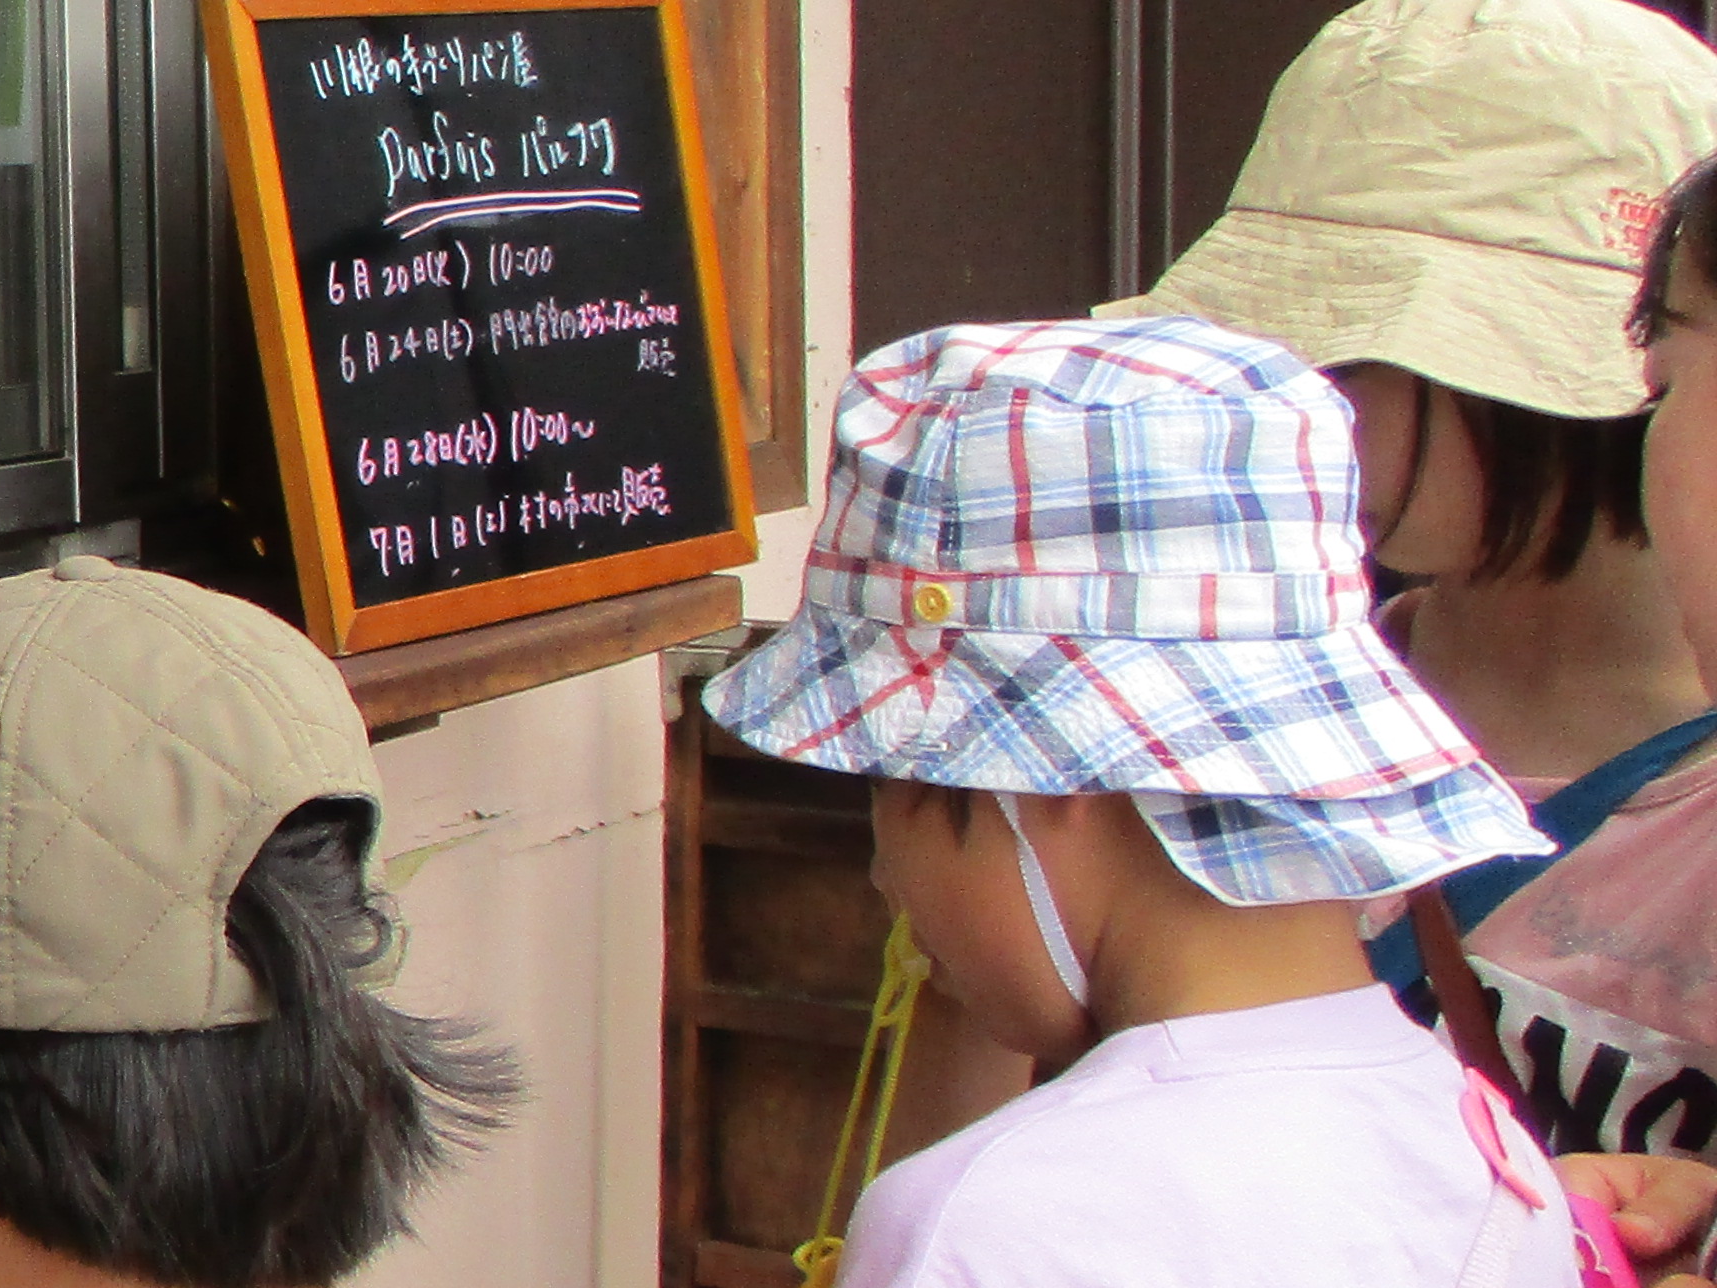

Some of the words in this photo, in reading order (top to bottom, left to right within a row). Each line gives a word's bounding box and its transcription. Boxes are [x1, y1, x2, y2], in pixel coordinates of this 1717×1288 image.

[520, 115, 619, 179] パルフワ
[489, 242, 555, 290] 10:00
